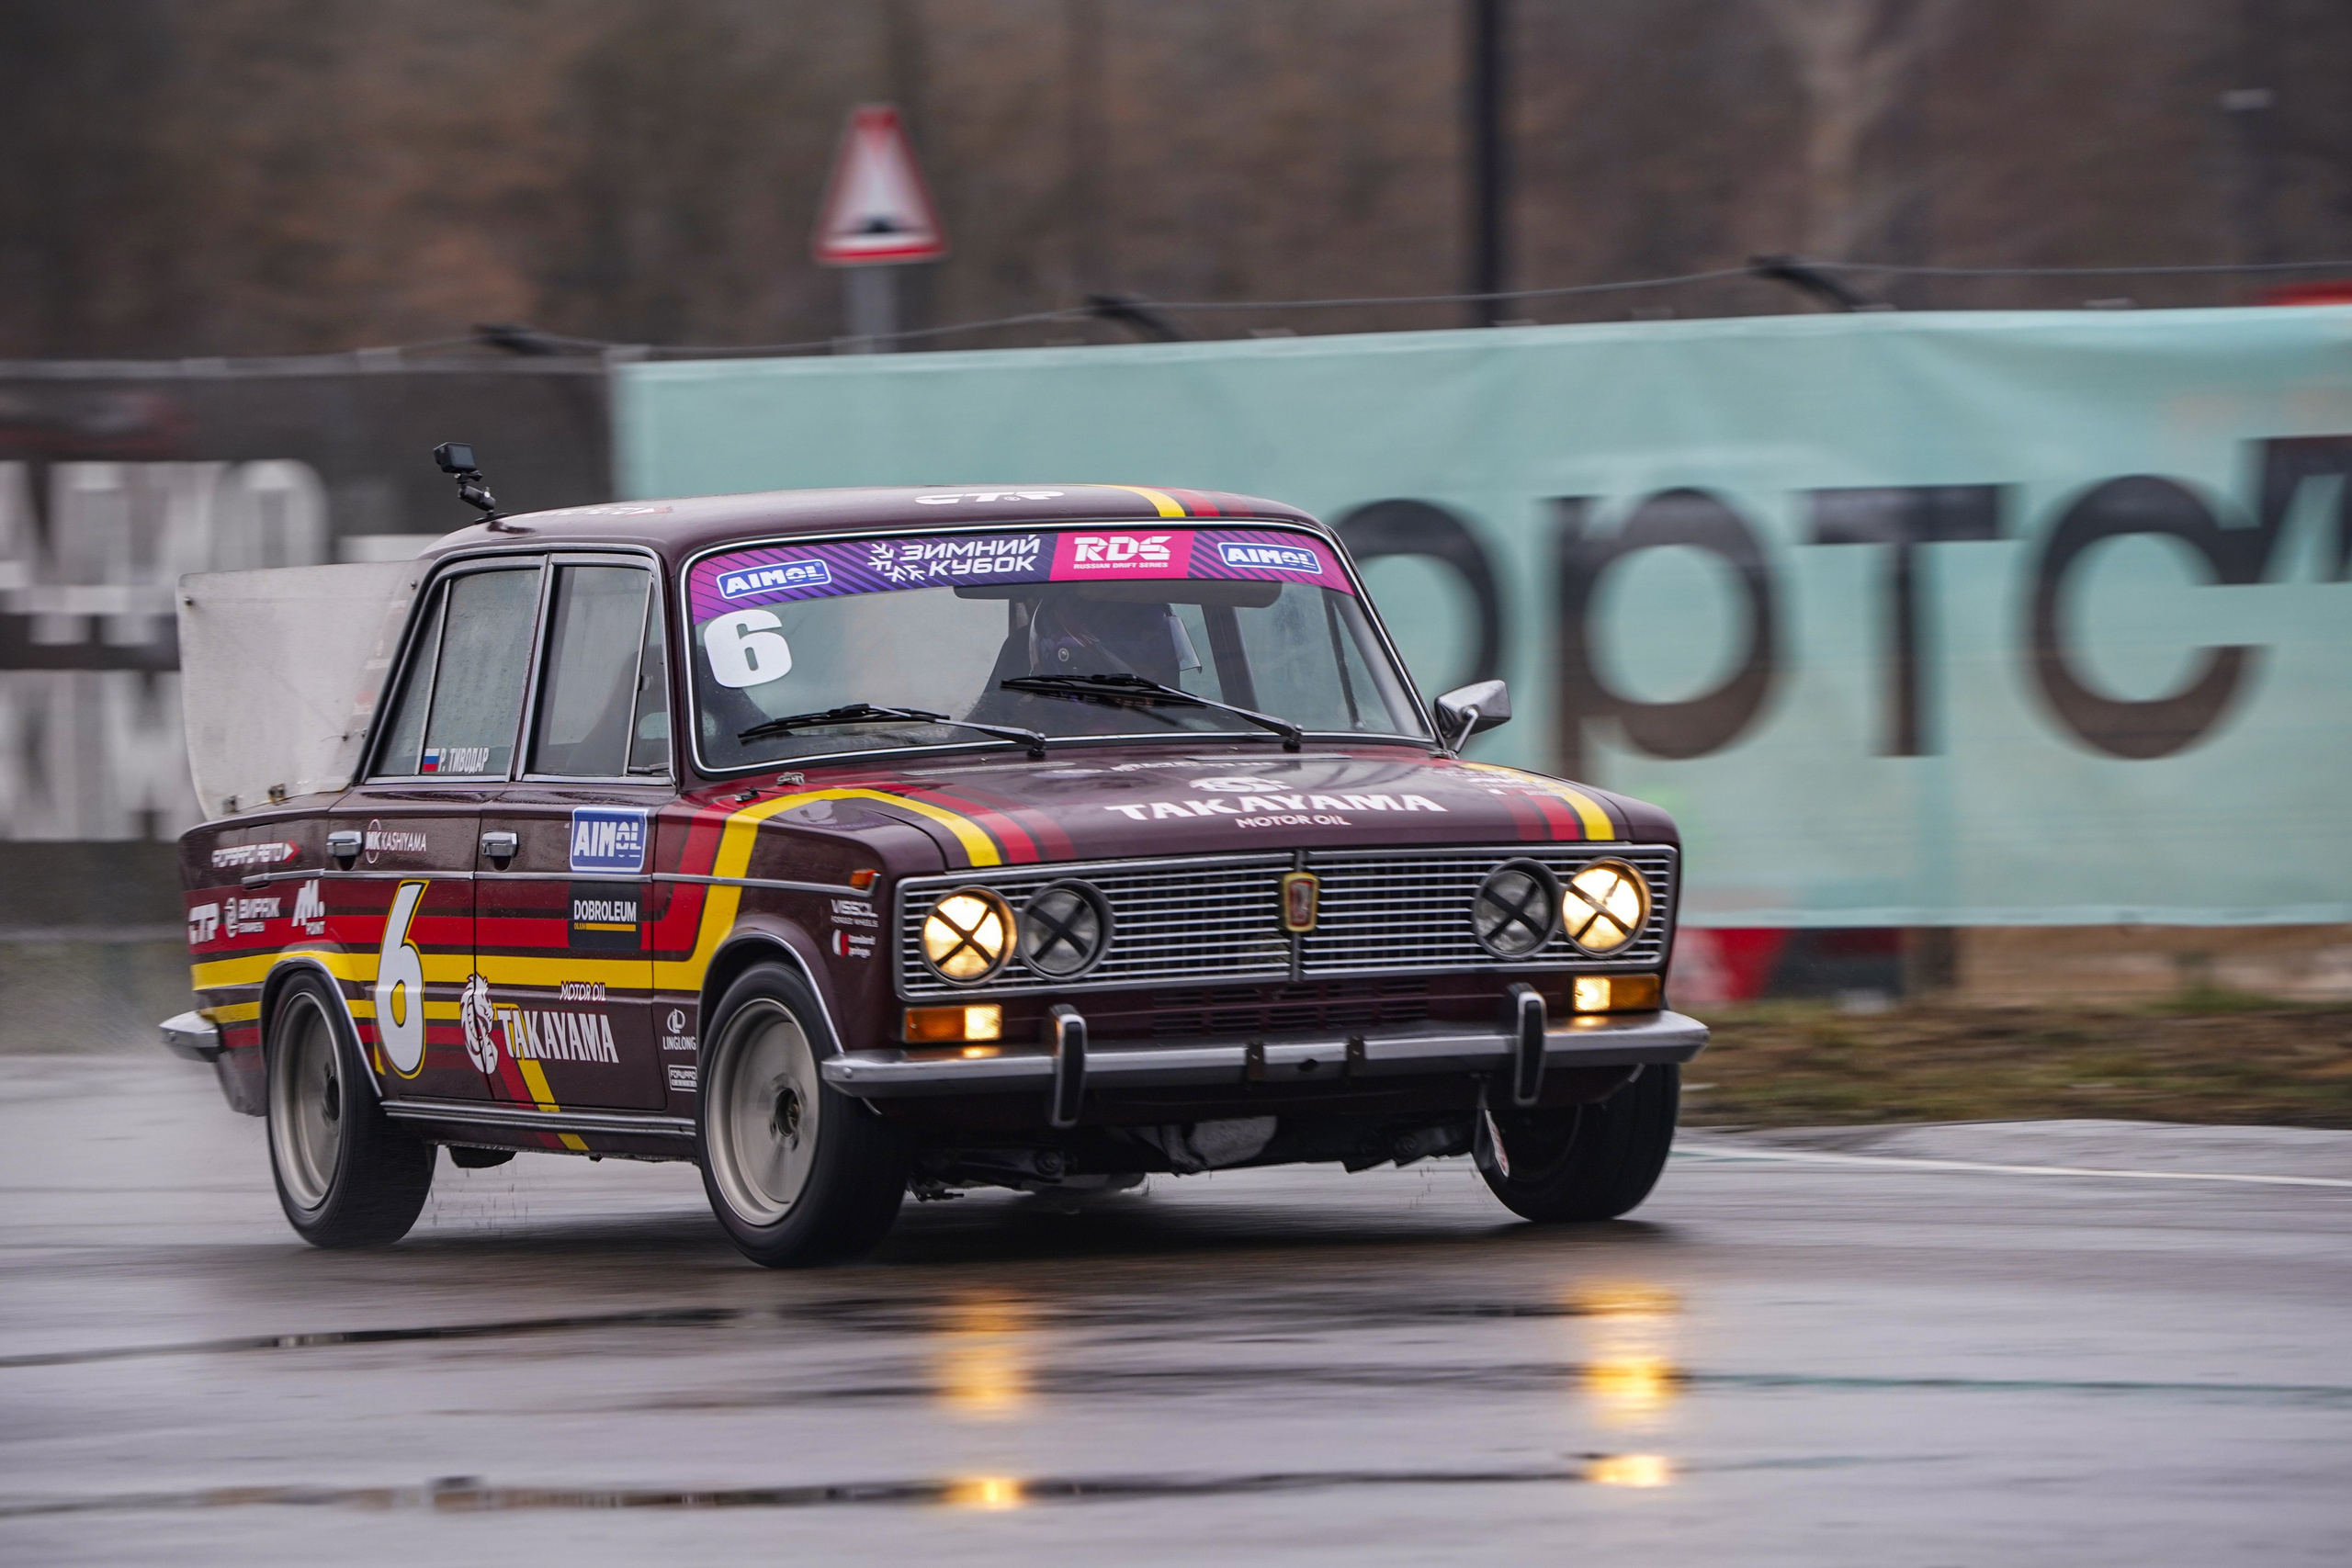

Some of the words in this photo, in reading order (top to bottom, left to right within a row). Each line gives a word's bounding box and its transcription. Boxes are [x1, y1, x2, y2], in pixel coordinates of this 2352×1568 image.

[900, 535, 1041, 561] ЗИМНИЙ
[1073, 536, 1172, 562] RDS
[1227, 547, 1317, 570] AIMOL
[928, 555, 1037, 577] КУБОК
[726, 565, 827, 594] AIMOL
[703, 609, 793, 689] 6
[448, 748, 490, 773] ТИВОДАР
[1104, 794, 1449, 822] TAKAYAMA
[1234, 813, 1311, 829] MOTOR
[1313, 814, 1352, 827] OIL
[381, 832, 427, 852] KASHIYAMA
[573, 820, 641, 858] AIMOL
[573, 899, 637, 922] DOBROLEUM
[374, 880, 429, 1079] 6
[560, 981, 591, 1001] MOTOR
[592, 983, 606, 1001] OIL
[497, 1009, 620, 1064] TAKAYAMA
[662, 1036, 697, 1051] LINGLONG
